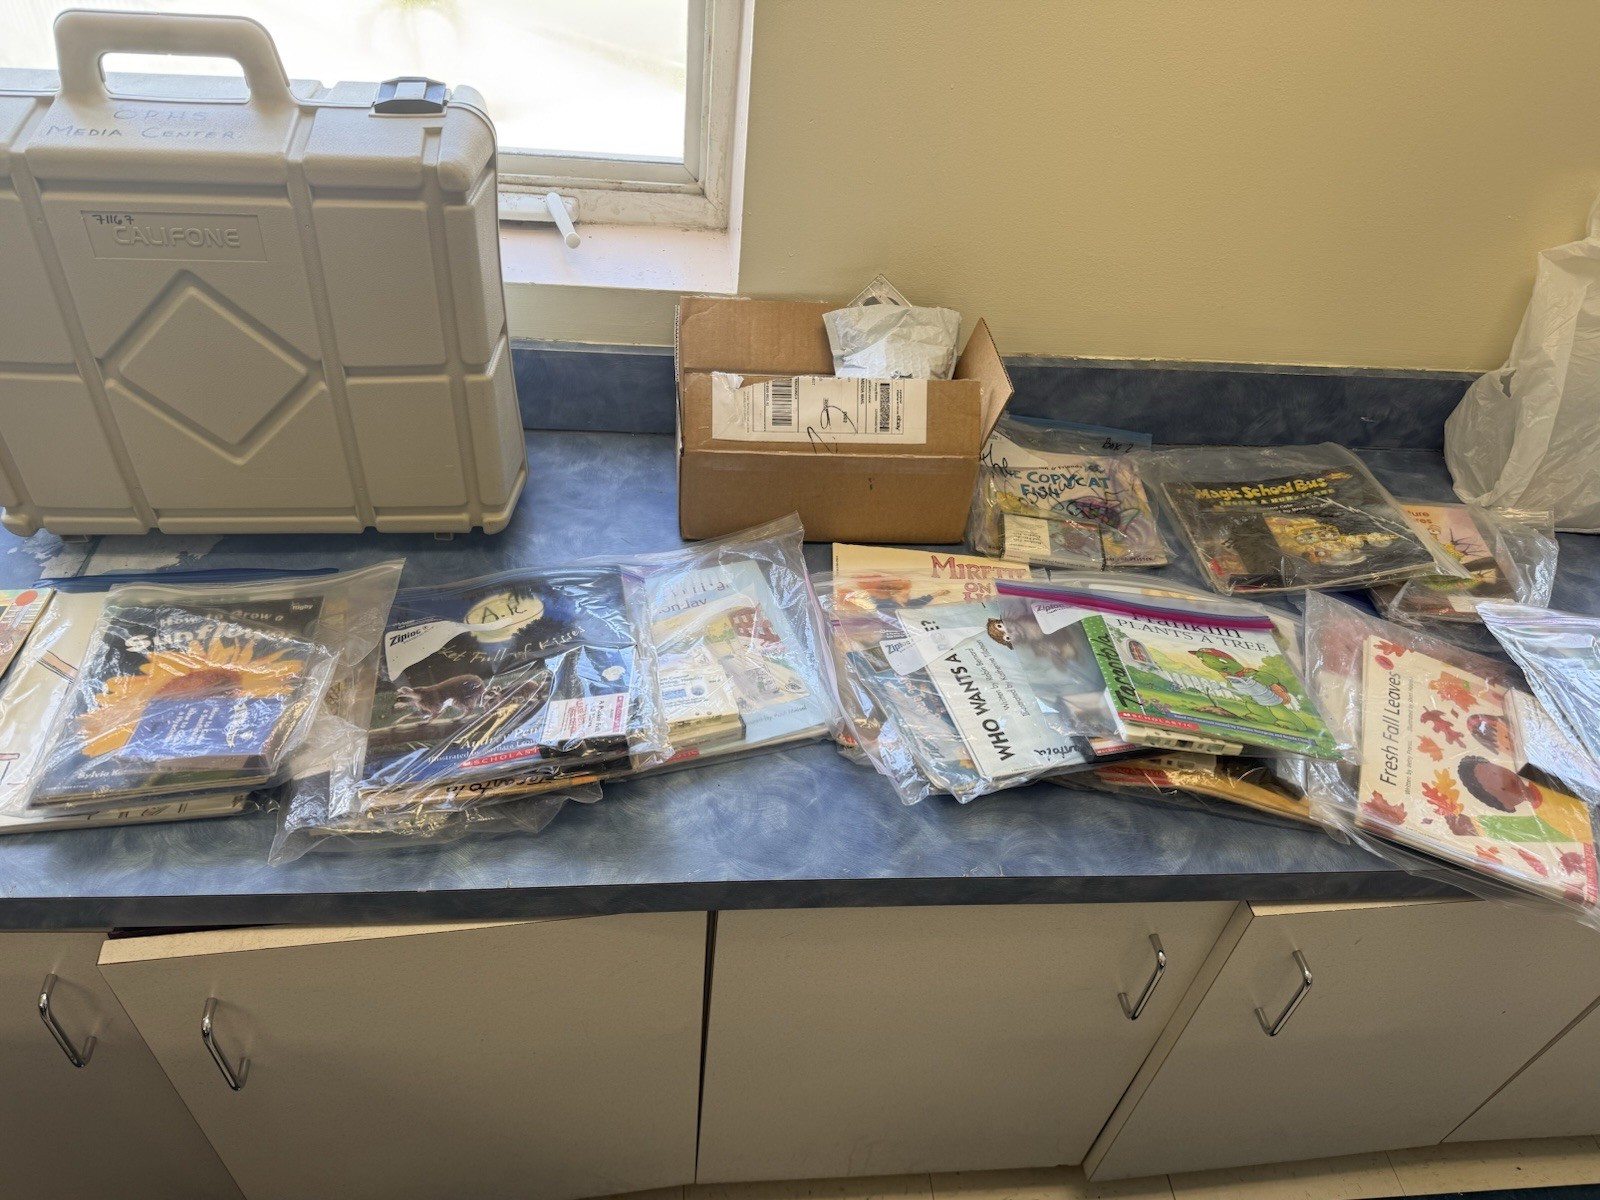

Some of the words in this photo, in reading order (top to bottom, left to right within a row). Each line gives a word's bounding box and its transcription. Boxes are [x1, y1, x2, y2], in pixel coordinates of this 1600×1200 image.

[46, 124, 122, 138] MEDIA
[92, 214, 136, 226] 71167
[113, 226, 241, 248] CALIFONE
[1026, 471, 1111, 490] COPYCAT
[1195, 487, 1242, 501] Magic
[1241, 481, 1294, 499] School
[1293, 477, 1328, 492] Bus
[963, 582, 991, 593] ON
[229, 609, 273, 621] Grow
[539, 625, 586, 650] Kisses
[1117, 618, 1194, 641] PLANTS
[1201, 635, 1214, 645] A
[1219, 637, 1269, 653] TREE
[945, 653, 961, 664] A
[950, 666, 990, 716] WANTS
[996, 689, 1010, 711] Written
[1384, 671, 1401, 716] Leaves
[1131, 713, 1194, 728] SCHOLASTIC
[1382, 715, 1400, 743] Fall
[982, 718, 1015, 761] WHO
[1379, 745, 1399, 786] Fresh
